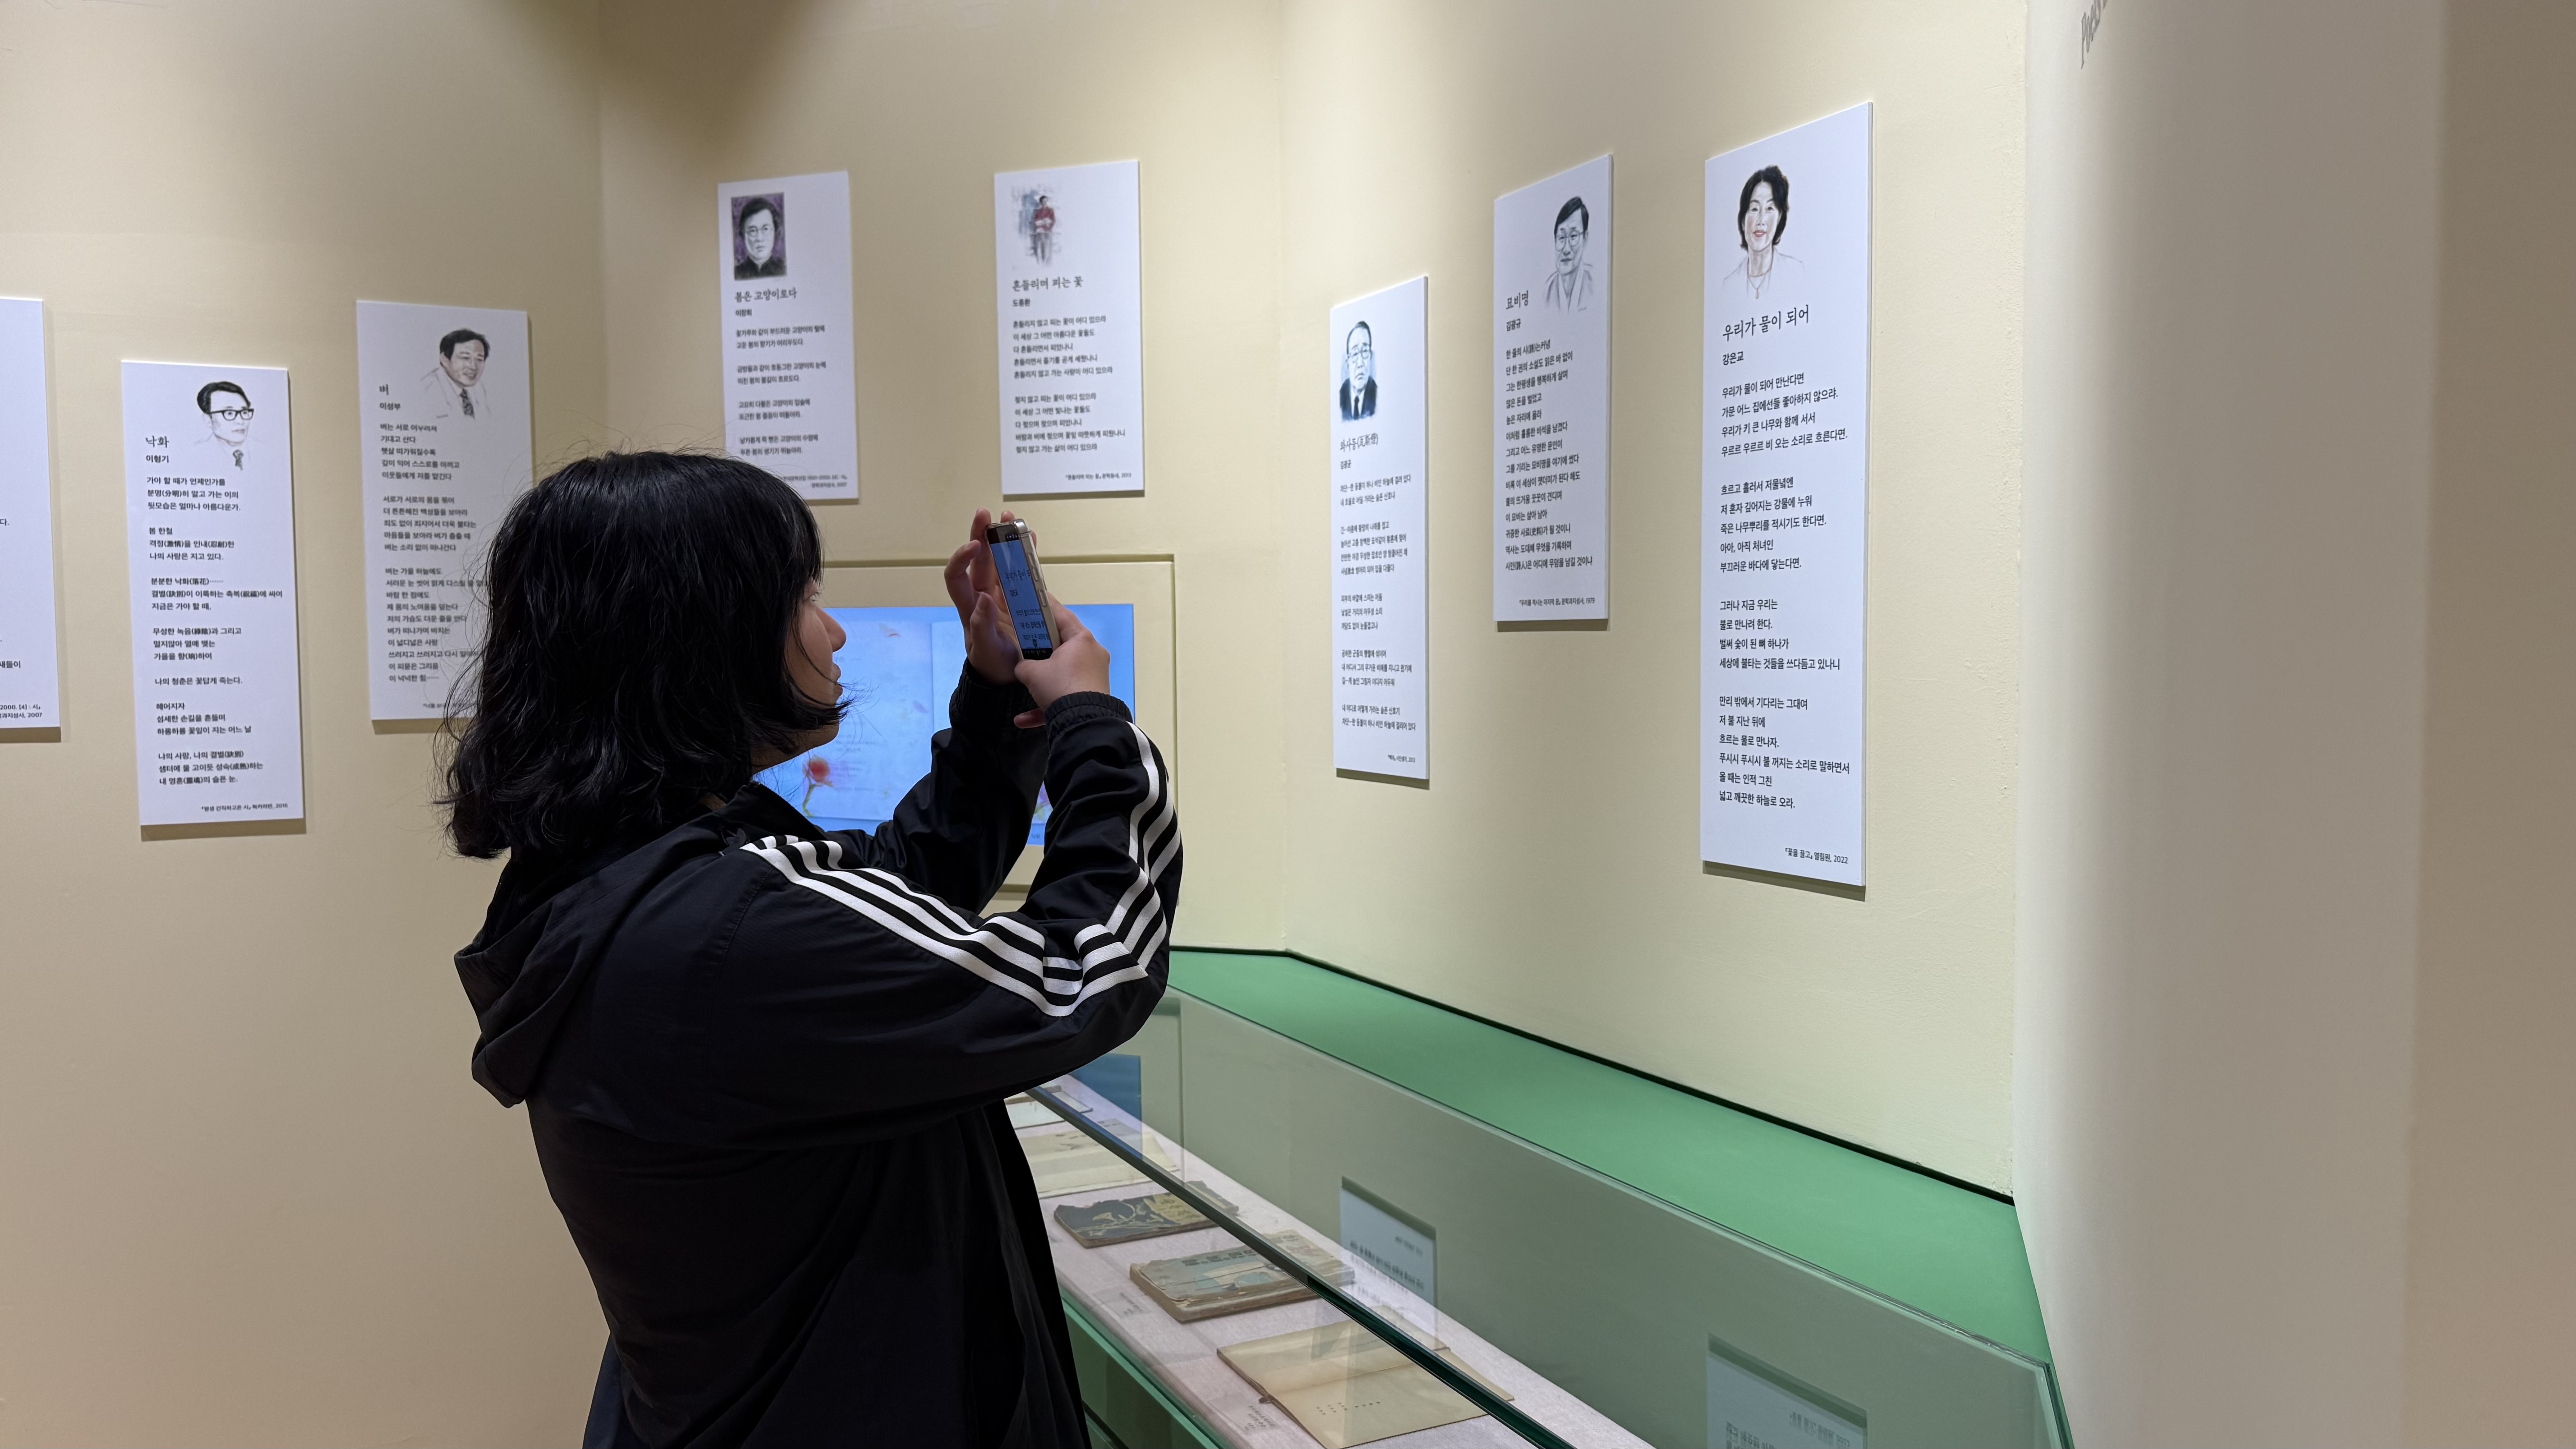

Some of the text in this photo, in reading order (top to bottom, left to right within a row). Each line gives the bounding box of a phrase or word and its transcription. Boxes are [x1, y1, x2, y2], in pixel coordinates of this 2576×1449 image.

[1723, 304, 1808, 341] 우리가 물이 되어
[1723, 351, 1743, 365] 강은교
[1722, 373, 1803, 398] 우리가 물이 되어 만난다면
[1722, 387, 1838, 417] 가문 어느 집에선들 좋아하지 않으랴.
[1722, 412, 1815, 437] 우리가 키 큰 나무와 함께 서서
[1721, 428, 1847, 456] 우르르 우르르 비 오는 소리로 흐른다면.
[1721, 477, 1793, 495] 흐르고 흘러서 저물녘엔
[1721, 495, 1812, 514] 저 혼자 깊어지는 강물에 누워
[1720, 514, 1826, 534] 죽은 나무뿌리를 적시기도 한다면.
[1720, 539, 1773, 553] 아아, 아직 처녀인
[1720, 557, 1801, 572] 부끄러운 바다에 닿는다면.
[1720, 599, 1777, 611] 그러나 지금 우리는
[1720, 618, 1772, 630] 불로 만나려 한다.
[1720, 638, 1789, 649] 벌써 숯이 된 뼈 하나가
[1720, 658, 1839, 670] 세상에 불타는 것들을 쓰다듬고 있나니
[1720, 696, 1807, 709] 만리 밖에서 기다리는 그대여
[1720, 715, 1765, 727] 저 불 지난 뒤에
[1719, 734, 1779, 748] 흐르는 물로 만나자.
[1719, 753, 1849, 774] 푸시시 푸시시 불 꺼지는 소리로 말하면서
[1719, 772, 1771, 787] 올 때는 인적 그친
[1720, 791, 1795, 809] 넓고 깨끗한 하늘로 오라.
